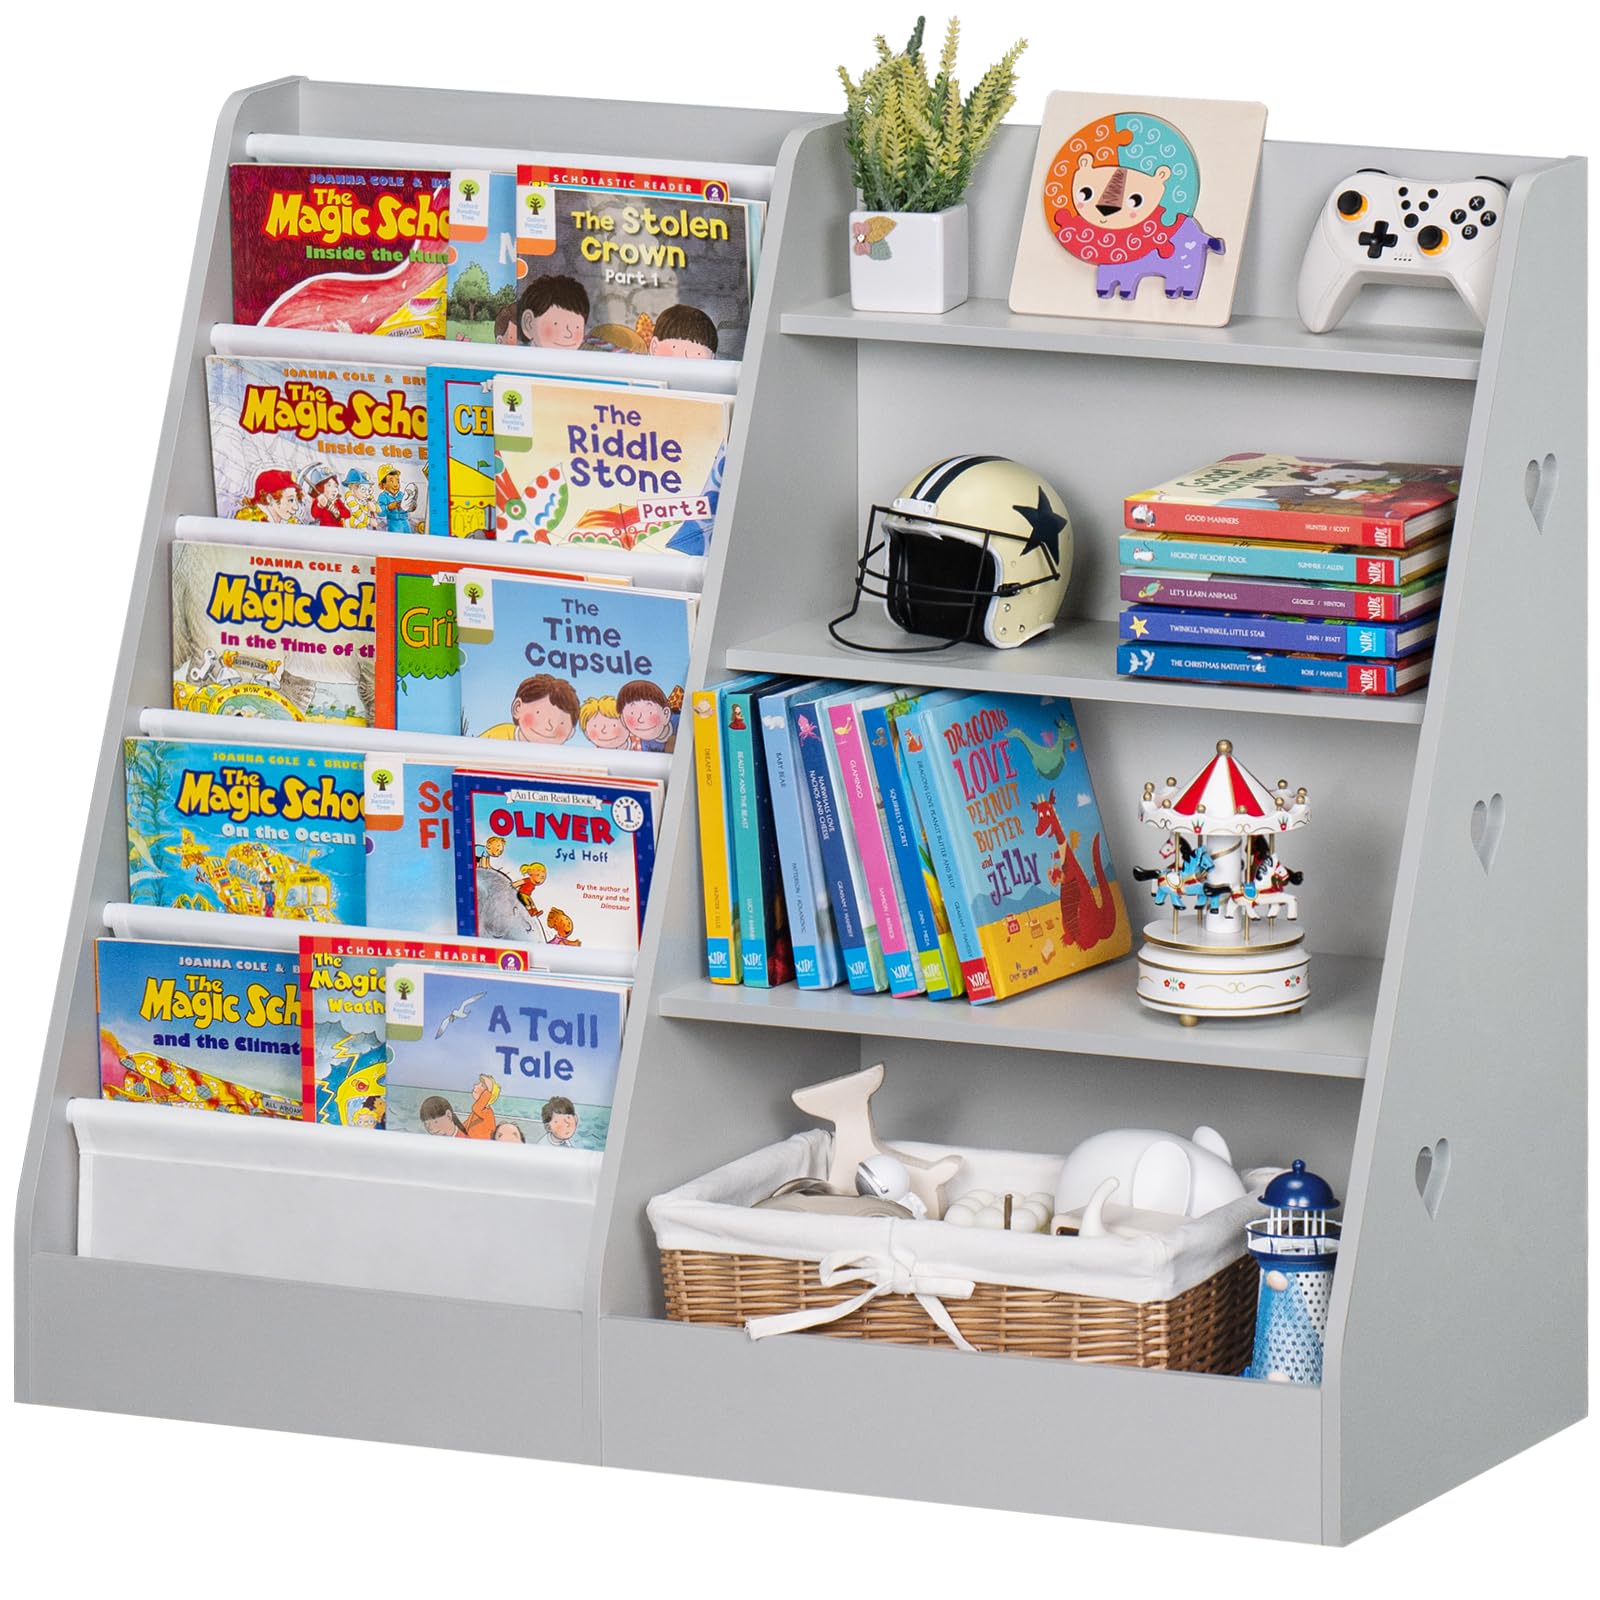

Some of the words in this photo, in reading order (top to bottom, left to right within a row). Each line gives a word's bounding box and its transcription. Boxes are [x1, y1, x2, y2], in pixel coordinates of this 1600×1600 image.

[309, 173, 366, 186] JOANNA
[370, 175, 404, 187] COLE
[412, 177, 422, 188] &
[553, 174, 636, 189] SCHOLASTIC
[643, 180, 692, 193] READER
[313, 188, 353, 206] The
[711, 187, 719, 197] 2
[1472, 198, 1480, 206] X
[265, 192, 371, 244] Magic
[571, 211, 614, 231] The
[622, 206, 728, 241] Stolen
[1454, 211, 1462, 220] Y
[1483, 213, 1491, 221] A
[1465, 226, 1473, 235] B
[305, 245, 366, 260] Inside
[371, 247, 403, 262] the
[581, 236, 686, 269] Crown
[605, 269, 645, 286] Part
[651, 275, 659, 287] 1
[283, 368, 337, 380] JOANNA
[343, 371, 375, 383] COLE
[384, 374, 393, 384] &
[288, 384, 327, 402] The
[242, 388, 347, 438] Magic
[351, 392, 427, 438] Scho
[454, 404, 494, 436] CH
[594, 405, 642, 427] The
[317, 440, 375, 456] Inside
[382, 444, 413, 459] the
[567, 424, 682, 463] Riddle
[570, 457, 682, 493] Stone
[642, 502, 691, 519] Part
[696, 500, 707, 516] 2
[1185, 514, 1205, 523] GOOD
[1207, 516, 1240, 525] MANNERS
[250, 556, 304, 570] JOANNA
[309, 561, 342, 572] COLE
[351, 565, 360, 574] &
[1171, 552, 1197, 560] HICKORY
[1200, 553, 1227, 561] DICKORY
[258, 573, 295, 593] The
[442, 574, 455, 582] An
[210, 576, 312, 630] Magic
[1186, 589, 1207, 598] LEARN
[1208, 591, 1237, 600] ANIMALS
[561, 598, 599, 616] The
[400, 607, 454, 649] Gri
[543, 616, 621, 648] Time
[1230, 628, 1248, 637] LITTLE
[221, 632, 239, 645] In
[246, 635, 276, 649] the
[281, 638, 327, 654] Time
[333, 643, 353, 656] of
[525, 642, 652, 678] Capsule
[1171, 659, 1183, 667] THE
[1184, 660, 1219, 669] CHRISTMAS
[1221, 662, 1249, 671] NATIVITY
[944, 709, 1009, 755] DRAGONS
[213, 752, 264, 763] JOANNA
[269, 756, 299, 766] COLE
[308, 759, 316, 767] &
[737, 751, 745, 776] BEAUTY
[222, 769, 260, 786] The
[953, 740, 1017, 801] LOVE
[738, 777, 746, 794] AND
[809, 770, 820, 798] NACHOS
[178, 772, 278, 821] Magic
[532, 792, 548, 801] Can
[550, 793, 570, 803] Read
[739, 795, 747, 808] THE
[818, 775, 830, 813] NARWHALS
[825, 814, 835, 832] LOVE
[967, 783, 1021, 825] PEANUT
[623, 805, 634, 823] 1
[815, 799, 824, 815] AND
[489, 808, 615, 845] OLIVER
[740, 809, 749, 829] BEAST
[818, 815, 828, 840] CHEESE
[222, 823, 249, 838] On
[255, 825, 289, 840] the
[295, 827, 356, 845] Ocean
[898, 824, 908, 847] SECRET
[925, 791, 934, 807] LOVE
[930, 808, 940, 834] PEANUT
[942, 858, 951, 873] AND
[975, 818, 1023, 853] BUTTER
[555, 848, 575, 862] Syd
[582, 850, 608, 862] Hoff
[981, 855, 993, 869] and
[576, 883, 585, 891] By
[599, 885, 620, 893] author
[583, 893, 604, 901] Danny
[600, 903, 630, 911] Dinosaur
[314, 952, 342, 967] The
[338, 945, 426, 958] SCHOLASTIC
[435, 949, 487, 963] READER
[507, 957, 515, 967] 2
[179, 957, 231, 969] JOANNA
[236, 960, 268, 972] COLE
[275, 964, 285, 973] &
[185, 974, 223, 993] The
[140, 978, 240, 1029] Magic
[328, 998, 385, 1014] Weath
[488, 1005, 511, 1034] A
[519, 1007, 598, 1049] Tall
[153, 1033, 190, 1047] and
[196, 1034, 229, 1049] the
[235, 1037, 300, 1055] Climat
[496, 1046, 574, 1081] Tale
